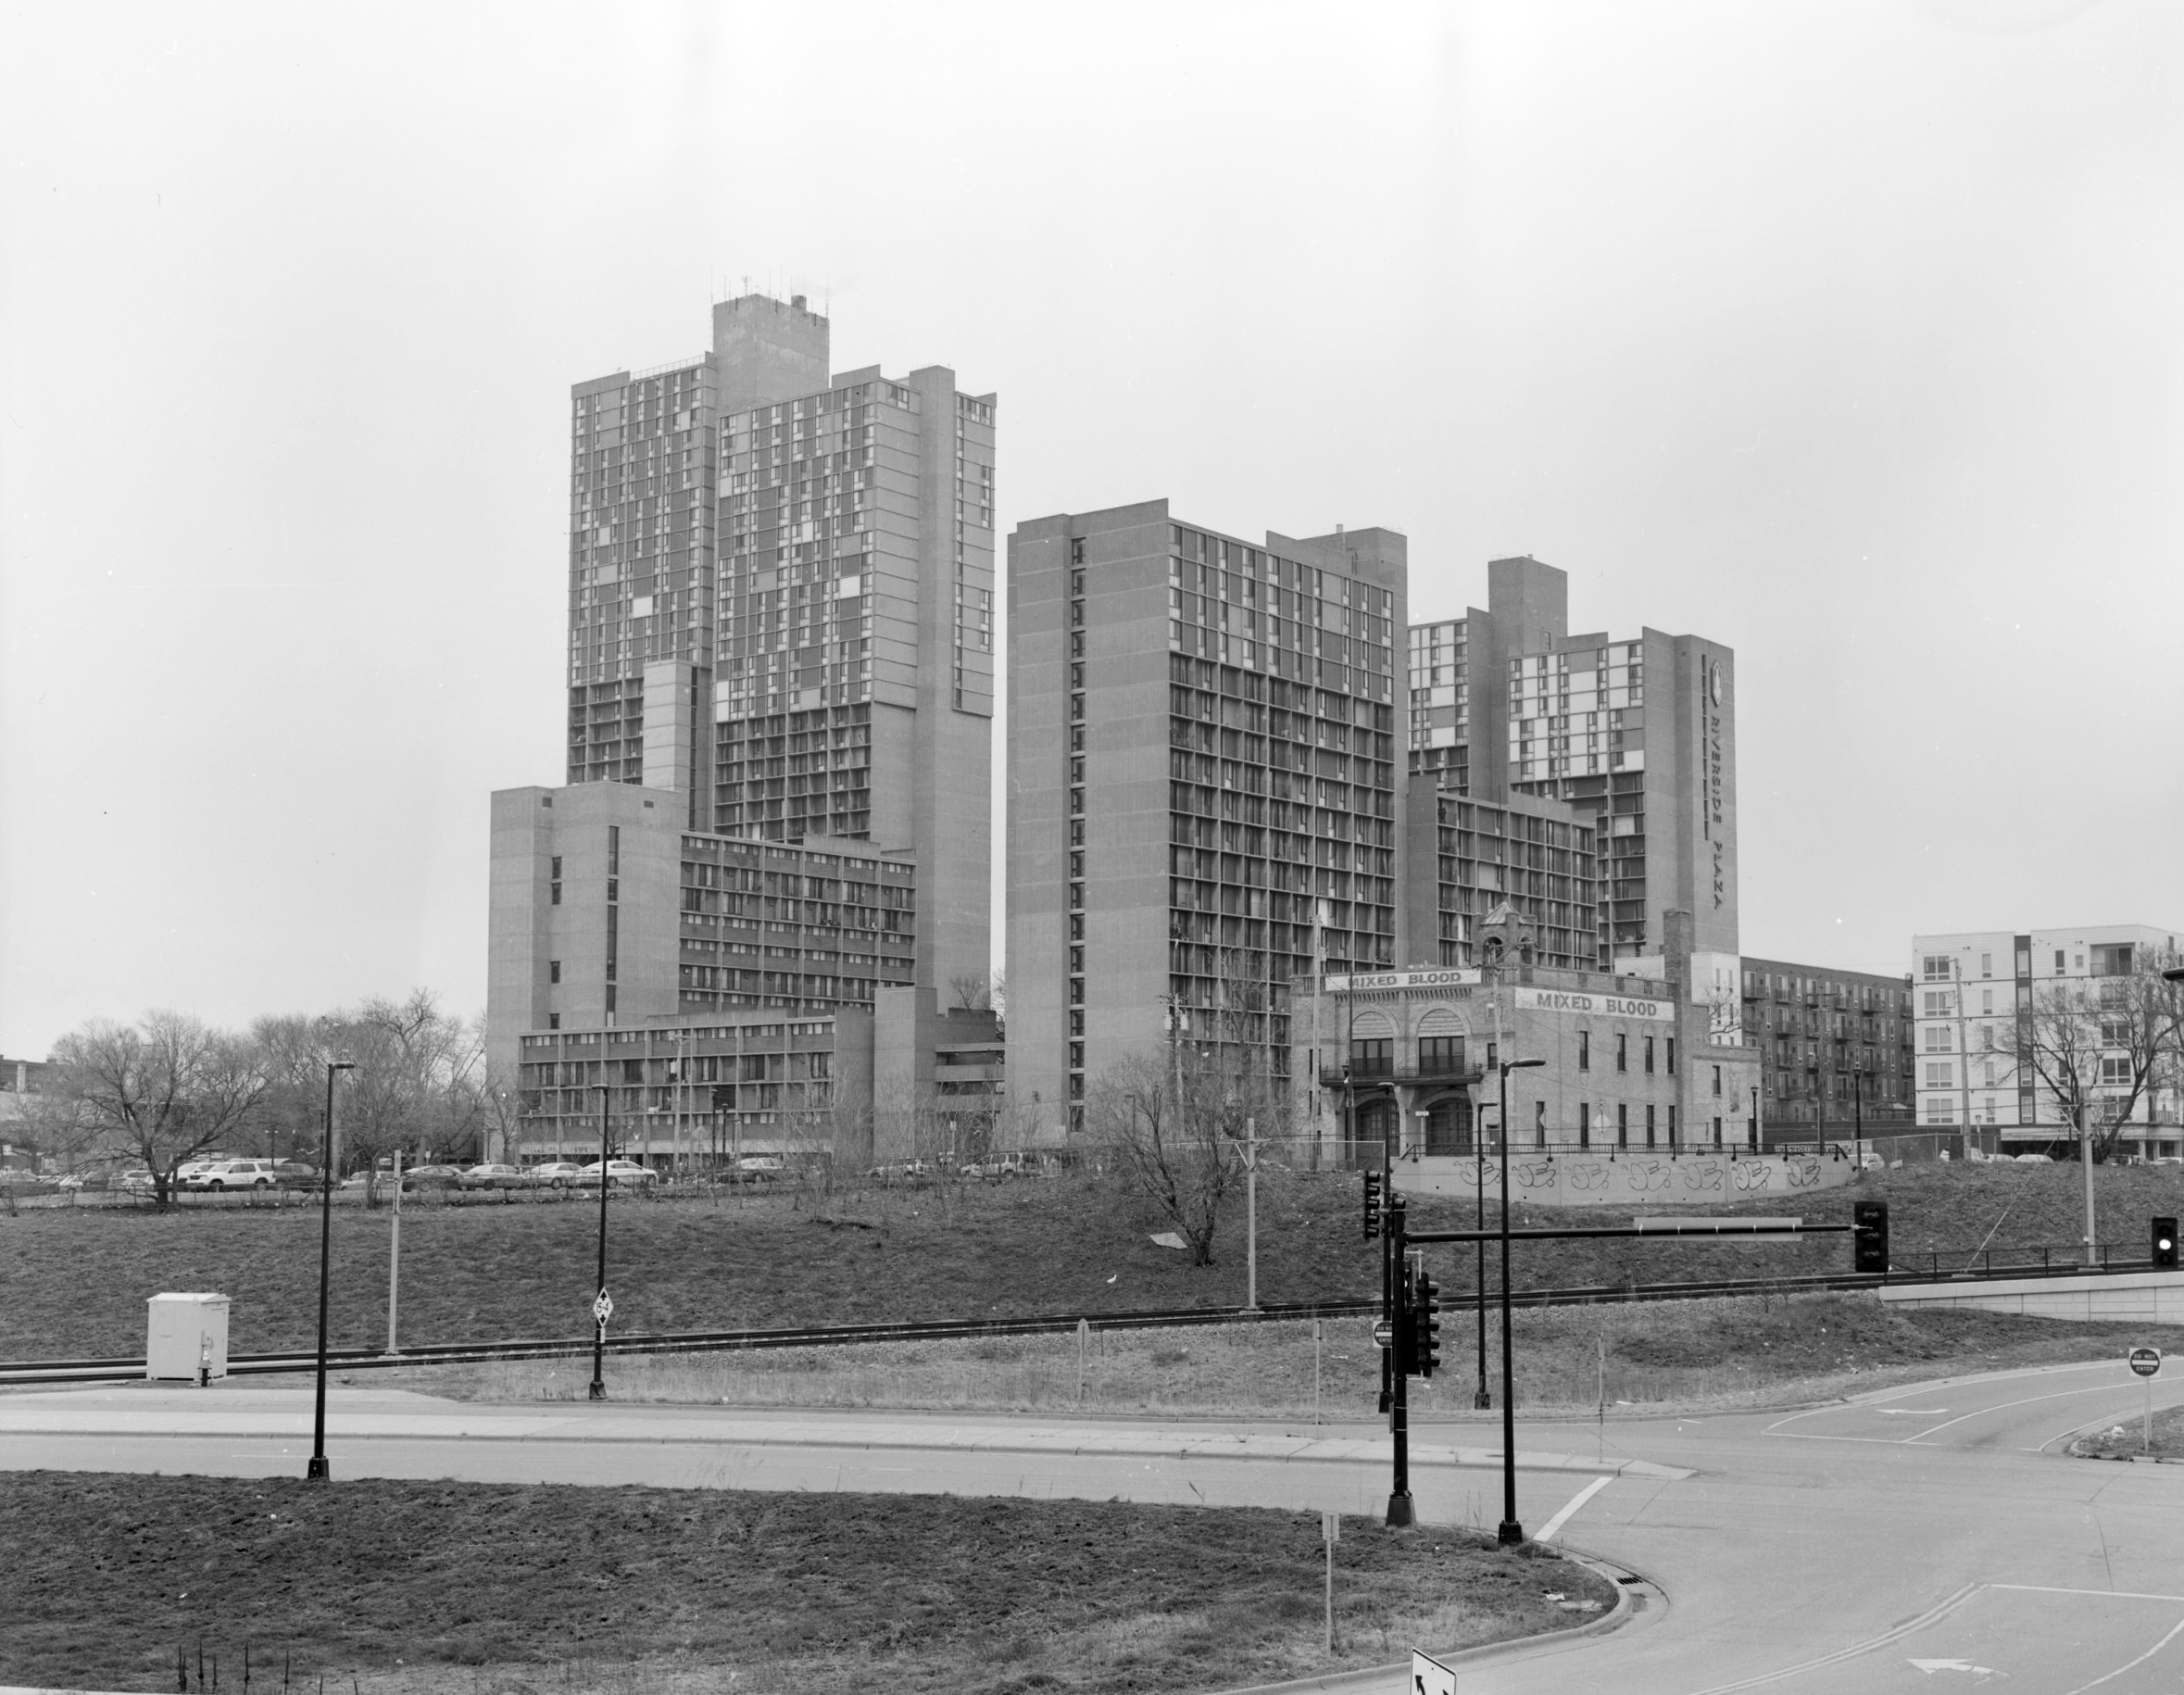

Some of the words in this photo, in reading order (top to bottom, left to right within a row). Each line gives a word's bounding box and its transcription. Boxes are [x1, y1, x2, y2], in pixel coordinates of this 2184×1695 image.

[1711, 716, 1722, 823] RIVERSIDE
[1713, 840, 1723, 910] PLAZA
[1348, 975, 1397, 988] MIXED
[1408, 972, 1462, 986] BLOOD
[1537, 993, 1593, 1011] MIXED
[1605, 998, 1657, 1017] BLOOD
